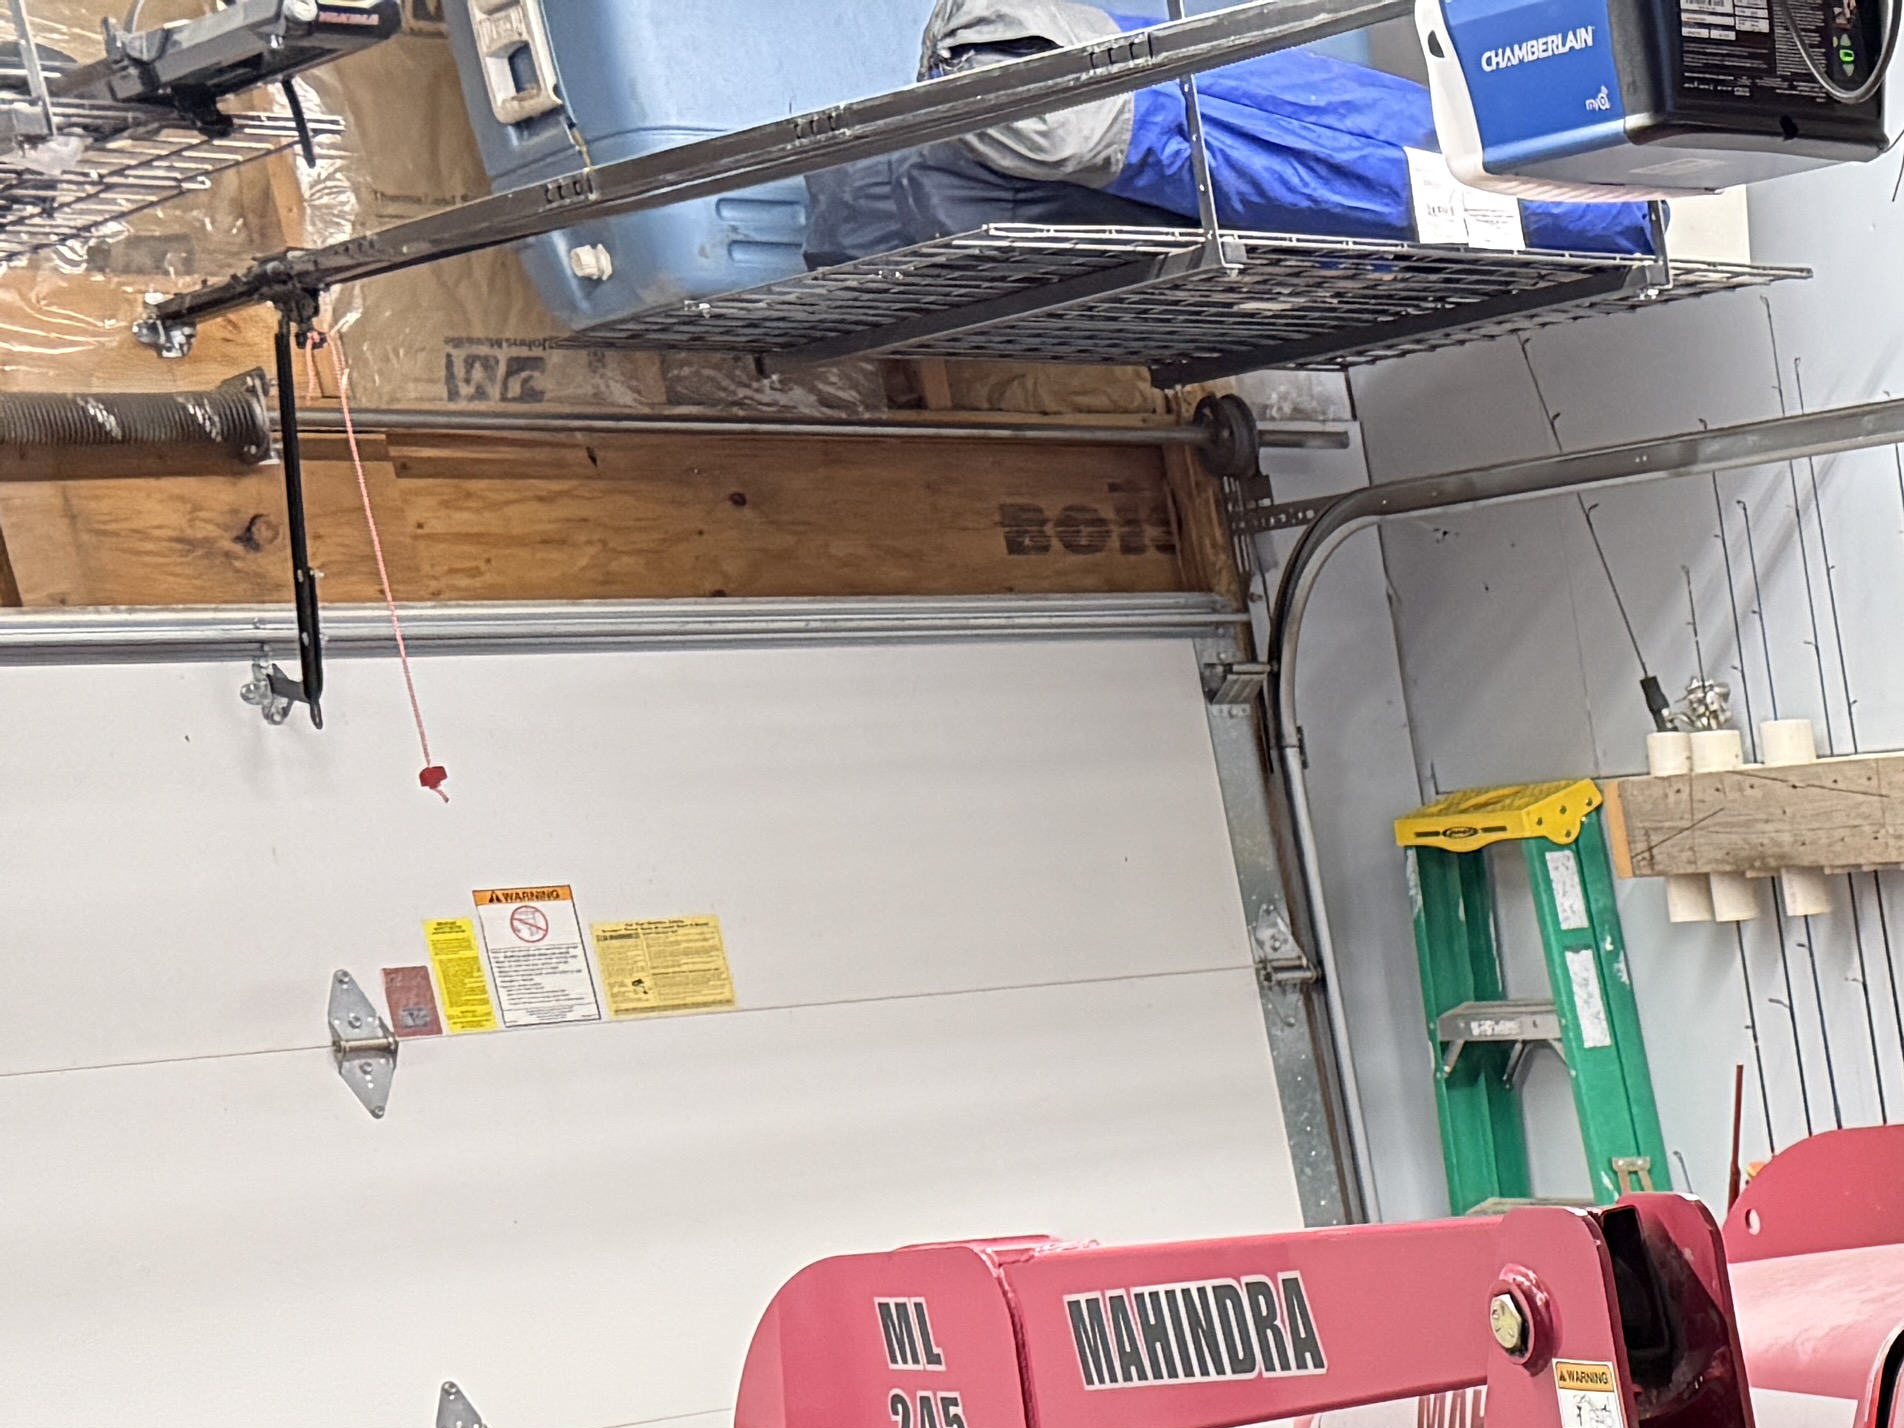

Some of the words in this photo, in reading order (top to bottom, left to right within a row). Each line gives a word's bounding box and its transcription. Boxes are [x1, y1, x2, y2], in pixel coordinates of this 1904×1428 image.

[1481, 26, 1595, 72] CHAMBERLAIN
[502, 889, 560, 903] WARNING
[875, 1297, 945, 1371] ML
[1064, 1272, 1327, 1389] MAHINDRA
[1566, 1368, 1609, 1386] WARNING
